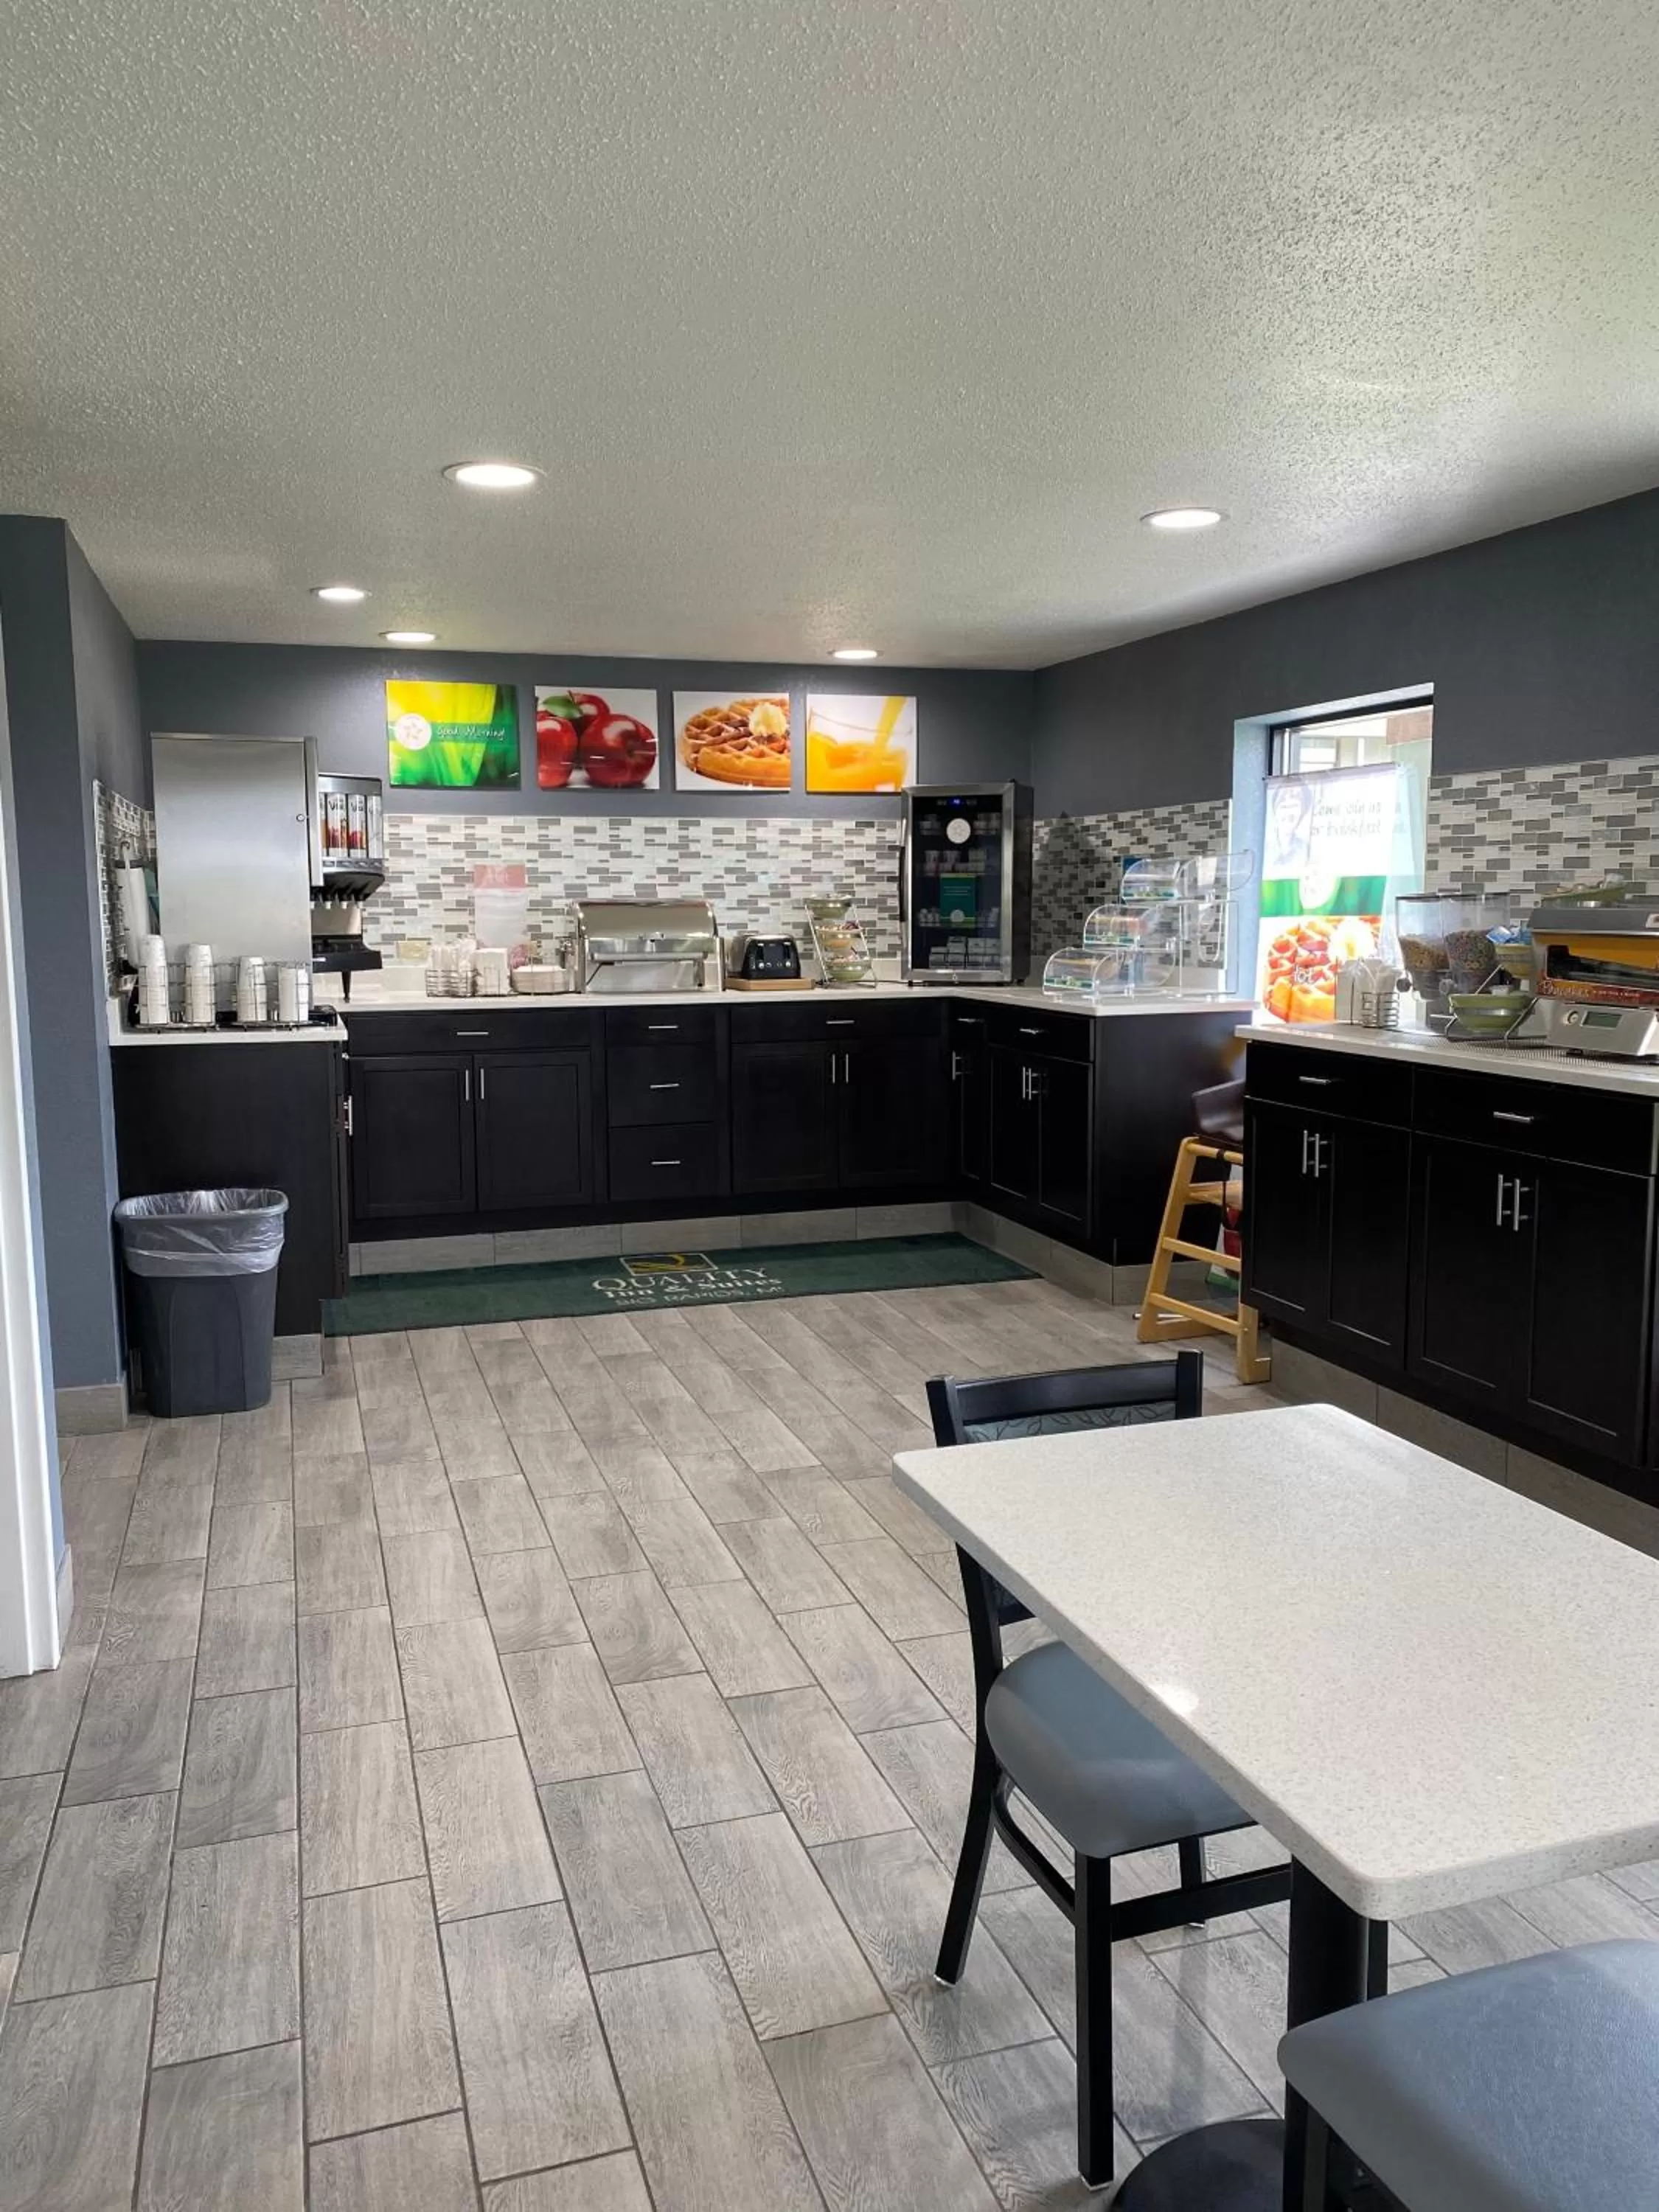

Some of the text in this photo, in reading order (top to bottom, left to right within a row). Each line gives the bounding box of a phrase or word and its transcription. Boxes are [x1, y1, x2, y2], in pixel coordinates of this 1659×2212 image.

[592, 1267, 768, 1290] QUALITY
[605, 1290, 654, 1298] Inn
[698, 1279, 782, 1289] Suites
